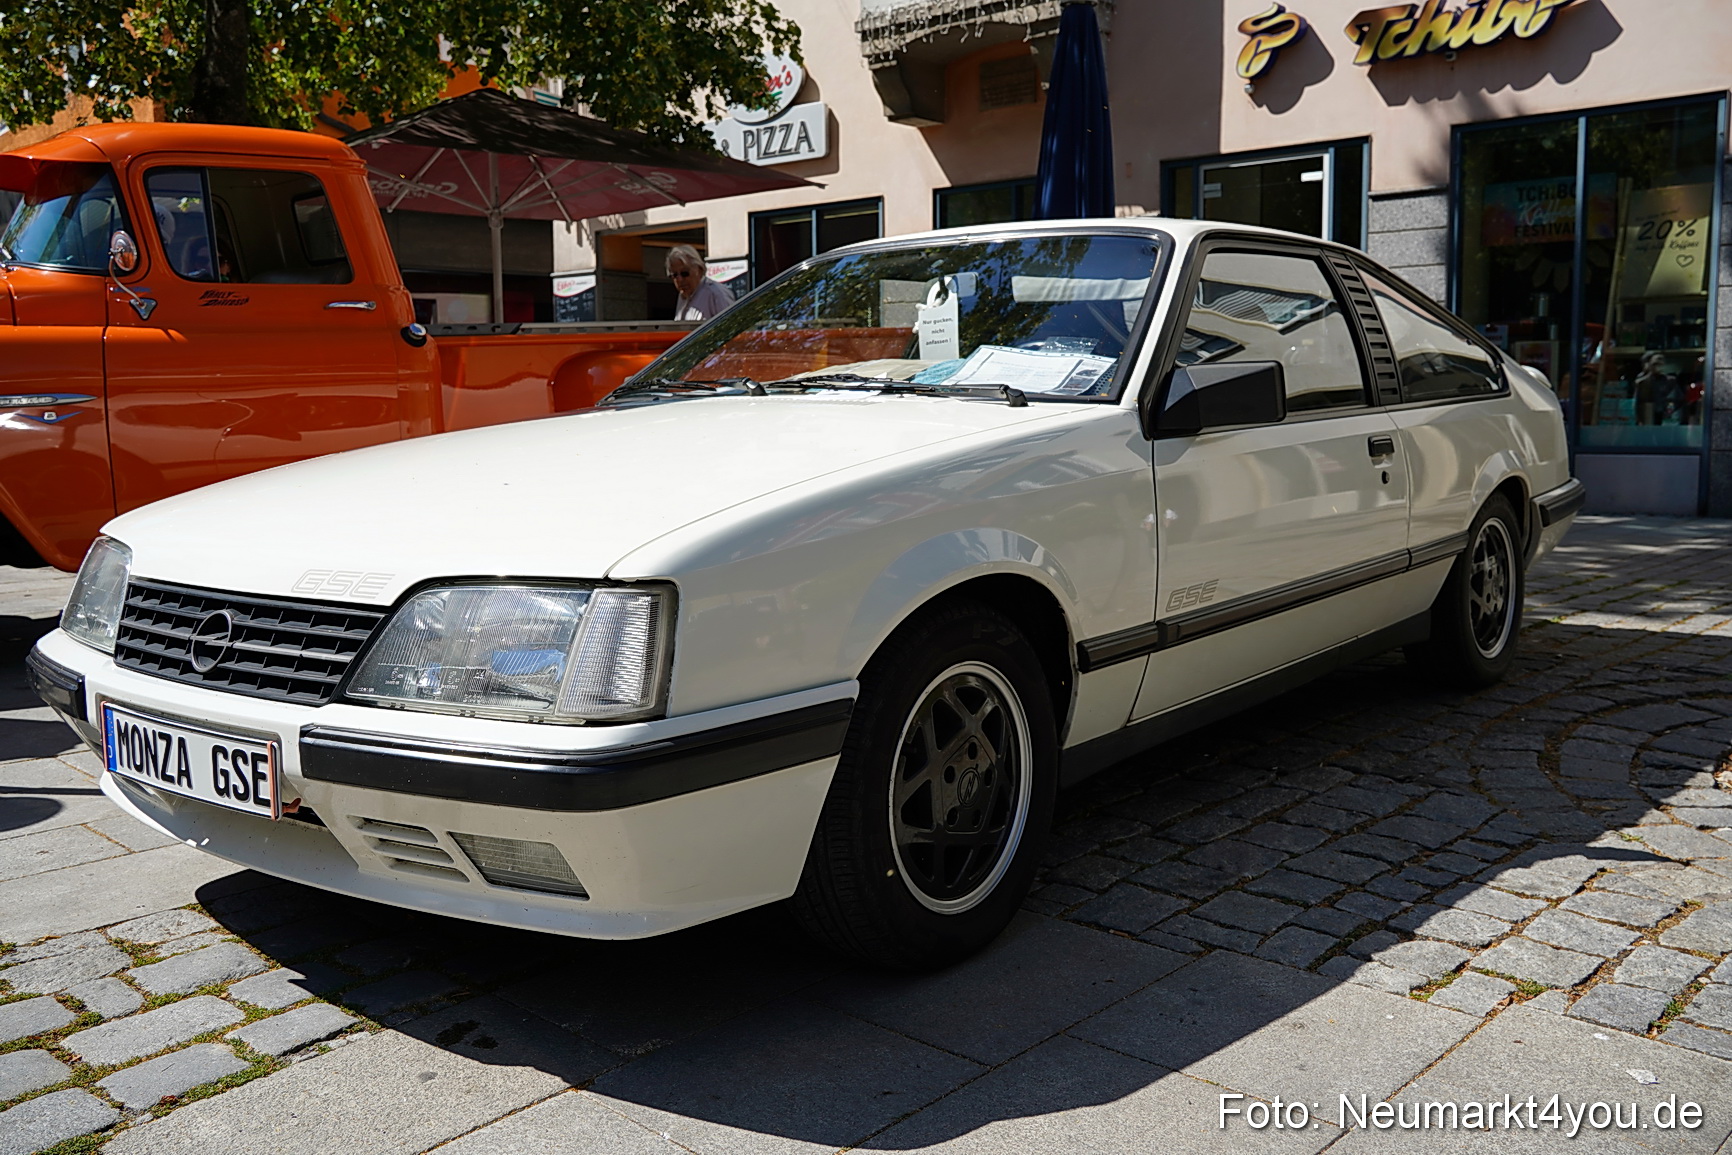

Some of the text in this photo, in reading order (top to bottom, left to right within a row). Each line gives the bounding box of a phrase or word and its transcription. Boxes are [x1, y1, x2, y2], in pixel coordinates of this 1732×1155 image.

[1344, 0, 1579, 64] Tchibo
[742, 120, 815, 161] PIZZA
[1638, 218, 1698, 241] 20%
[291, 569, 396, 599] GSE
[1166, 579, 1219, 612] GSE
[116, 718, 271, 807] MONZA GSE
